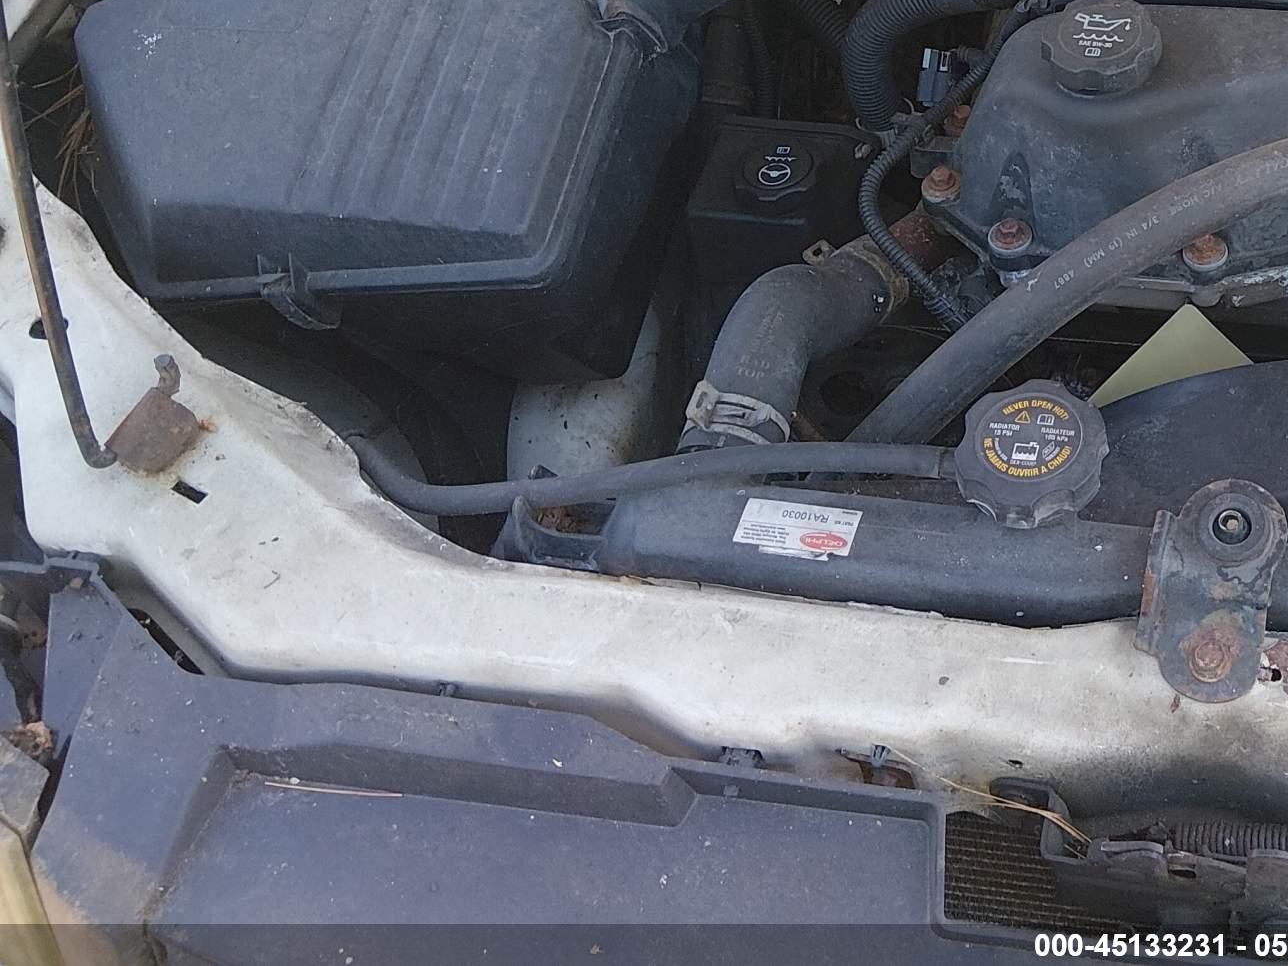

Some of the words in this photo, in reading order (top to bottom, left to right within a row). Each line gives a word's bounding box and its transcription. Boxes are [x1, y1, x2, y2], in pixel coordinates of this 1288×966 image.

[1141, 215, 1161, 231] 3/4
[1126, 227, 1139, 240] IN
[1083, 248, 1105, 268] MM)
[1003, 400, 1030, 415] NEVER
[1031, 399, 1053, 411] OPEN
[989, 422, 1021, 431] RADIATOR
[985, 448, 1008, 472] JAMAIS
[1008, 467, 1040, 477] OUVRIR
[781, 509, 830, 524] RA10030
[805, 537, 844, 547] DELPHI
